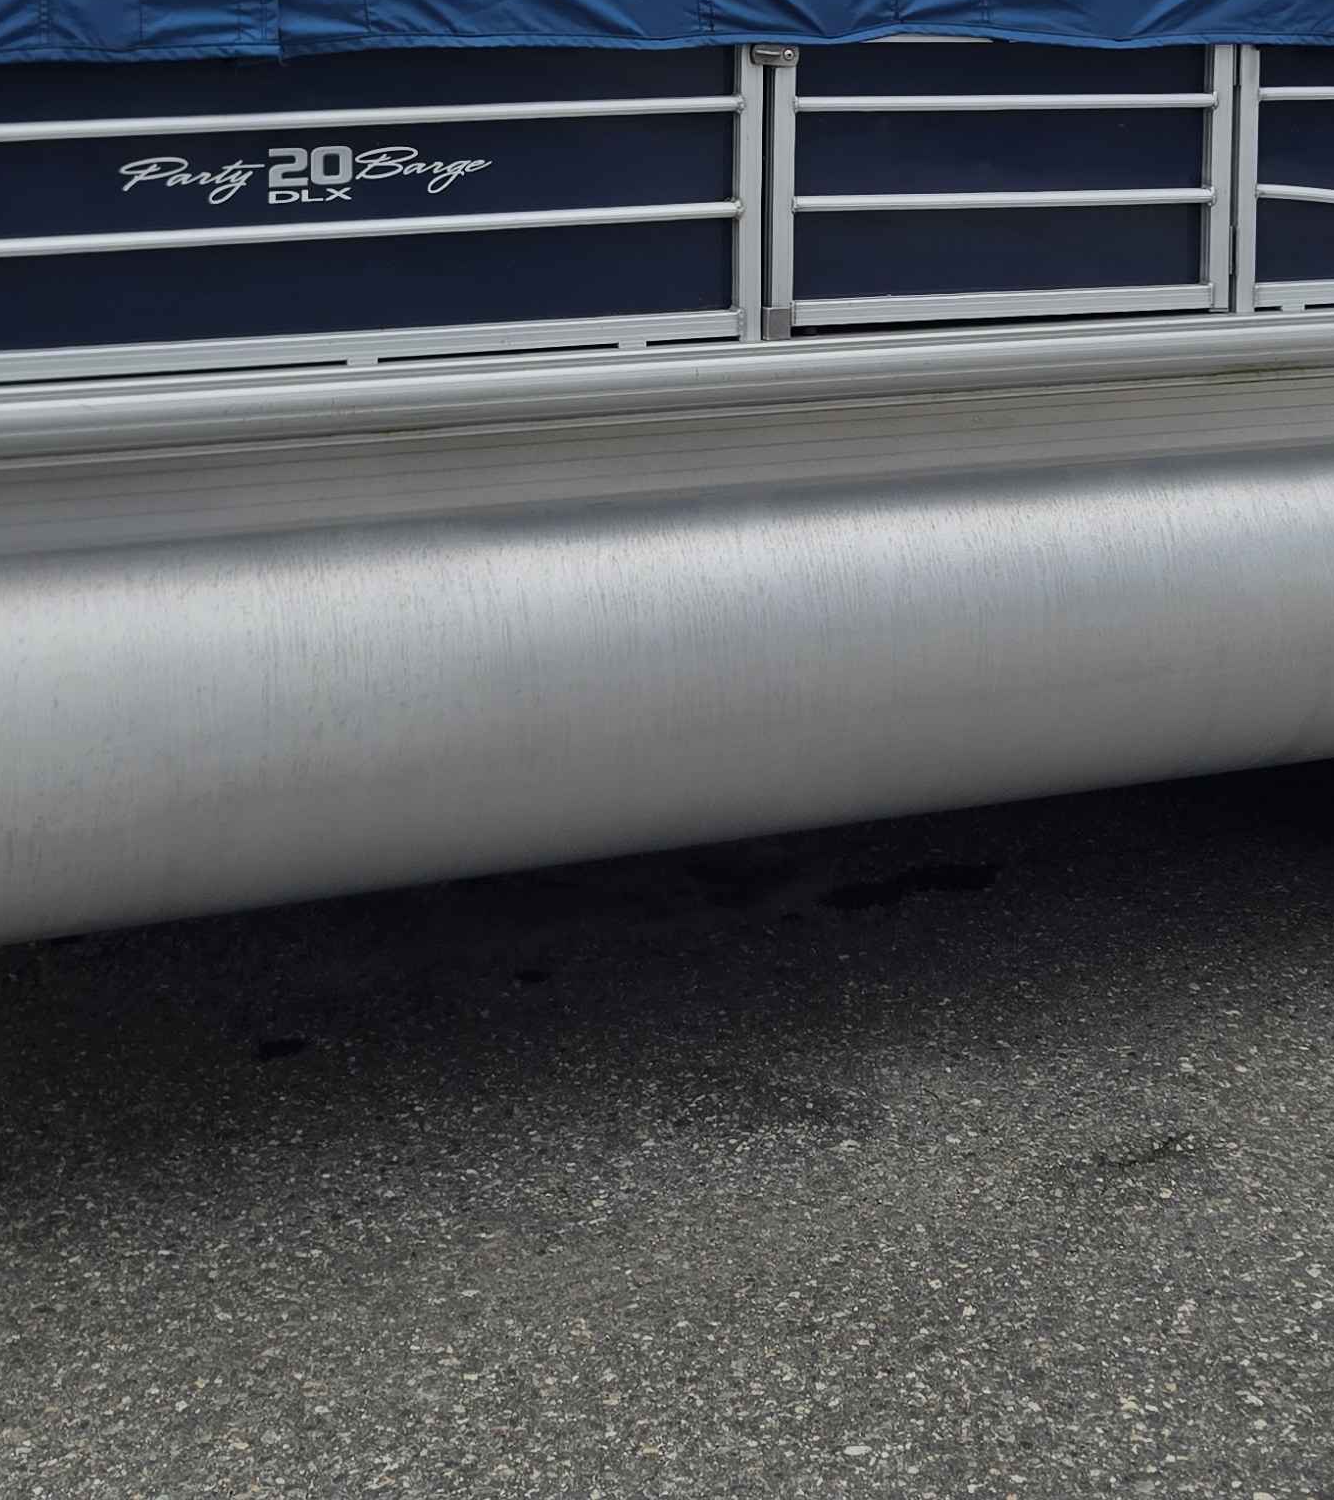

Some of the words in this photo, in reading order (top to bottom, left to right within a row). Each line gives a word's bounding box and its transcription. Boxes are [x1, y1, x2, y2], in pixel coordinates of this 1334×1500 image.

[118, 156, 266, 205] Party
[268, 145, 353, 189] 20
[354, 146, 493, 194] Barge
[267, 186, 353, 205] DLX
